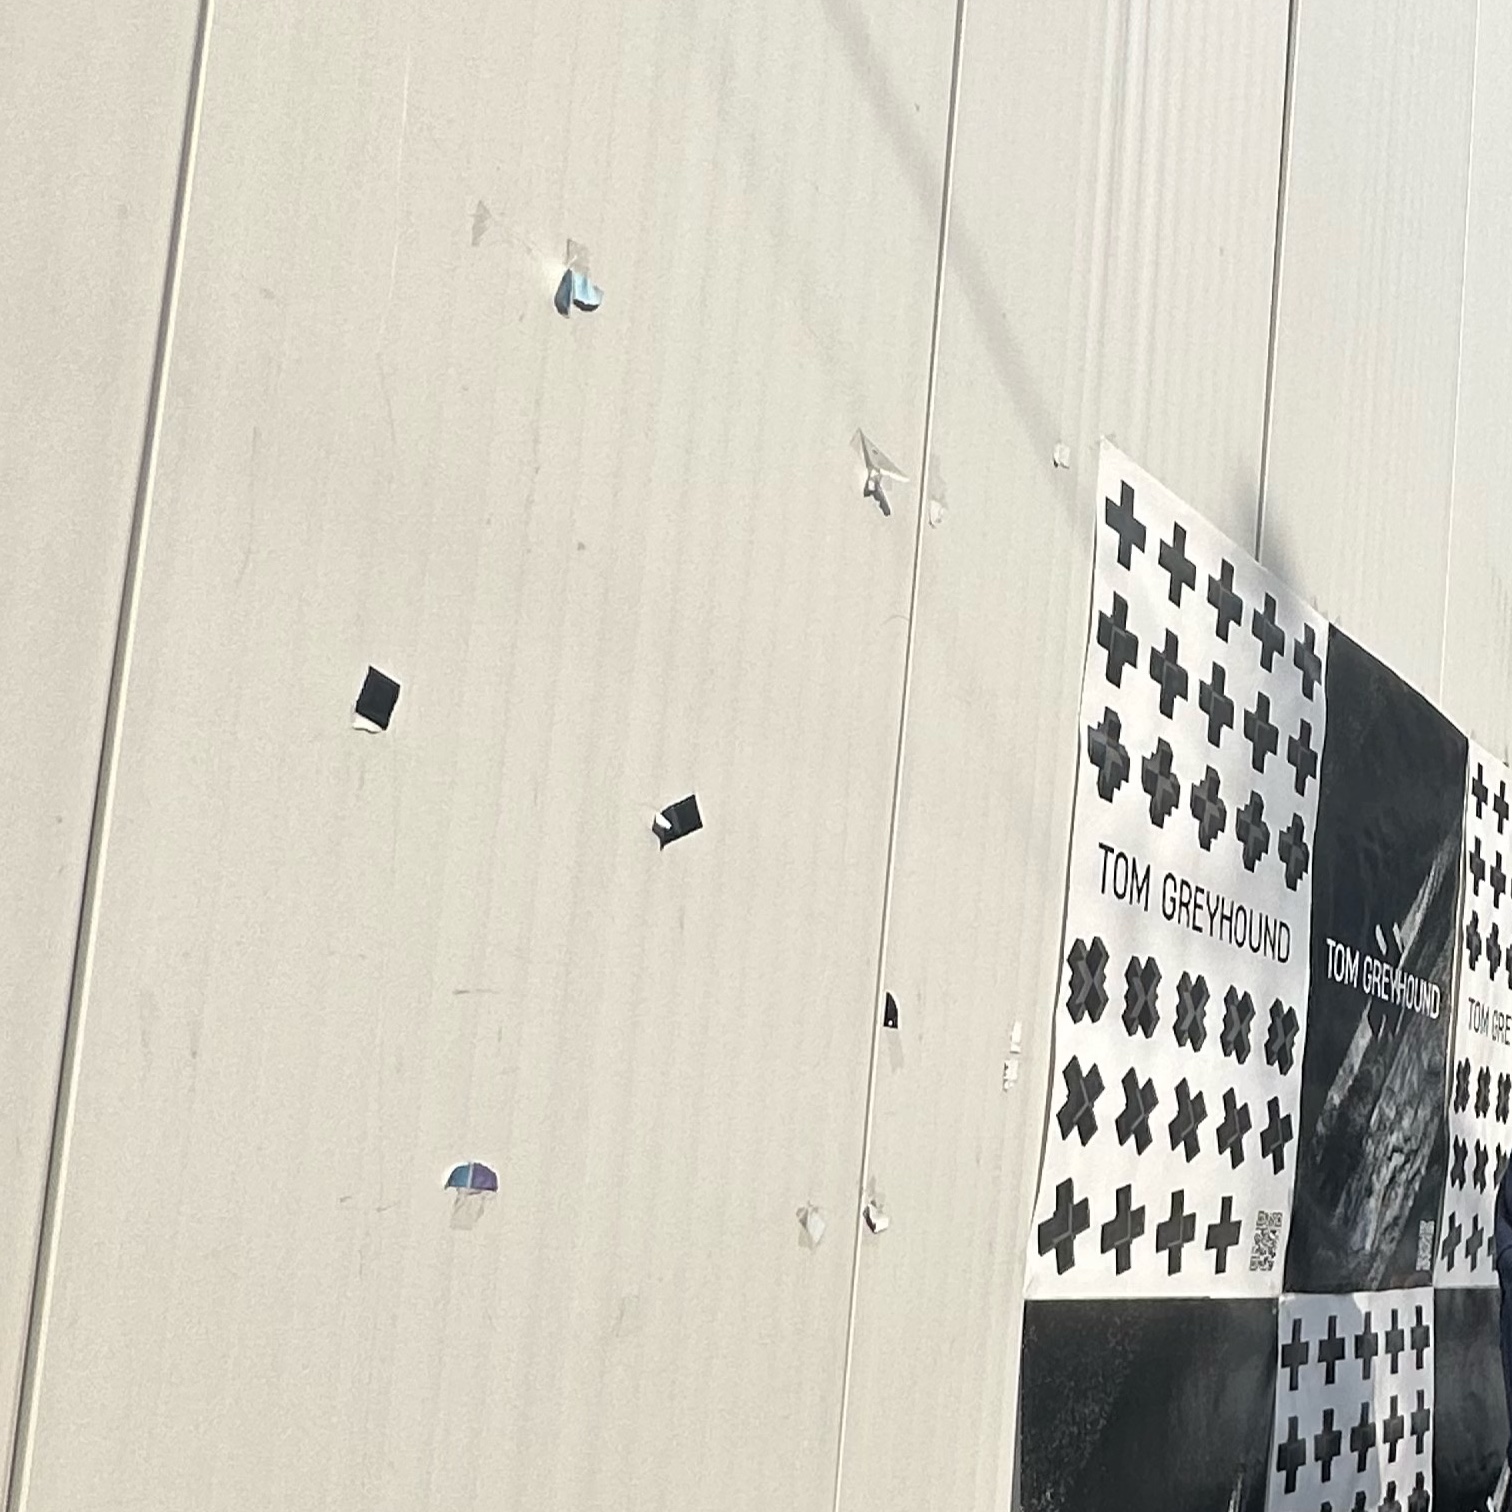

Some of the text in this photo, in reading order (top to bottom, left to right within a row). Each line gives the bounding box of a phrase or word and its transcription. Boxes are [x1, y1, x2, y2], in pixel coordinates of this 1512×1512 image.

[1099, 842, 1291, 963] TOM GREYHOUND
[1326, 938, 1441, 1020] TOM GREYHOUND
[1468, 996, 1490, 1037] TOM
